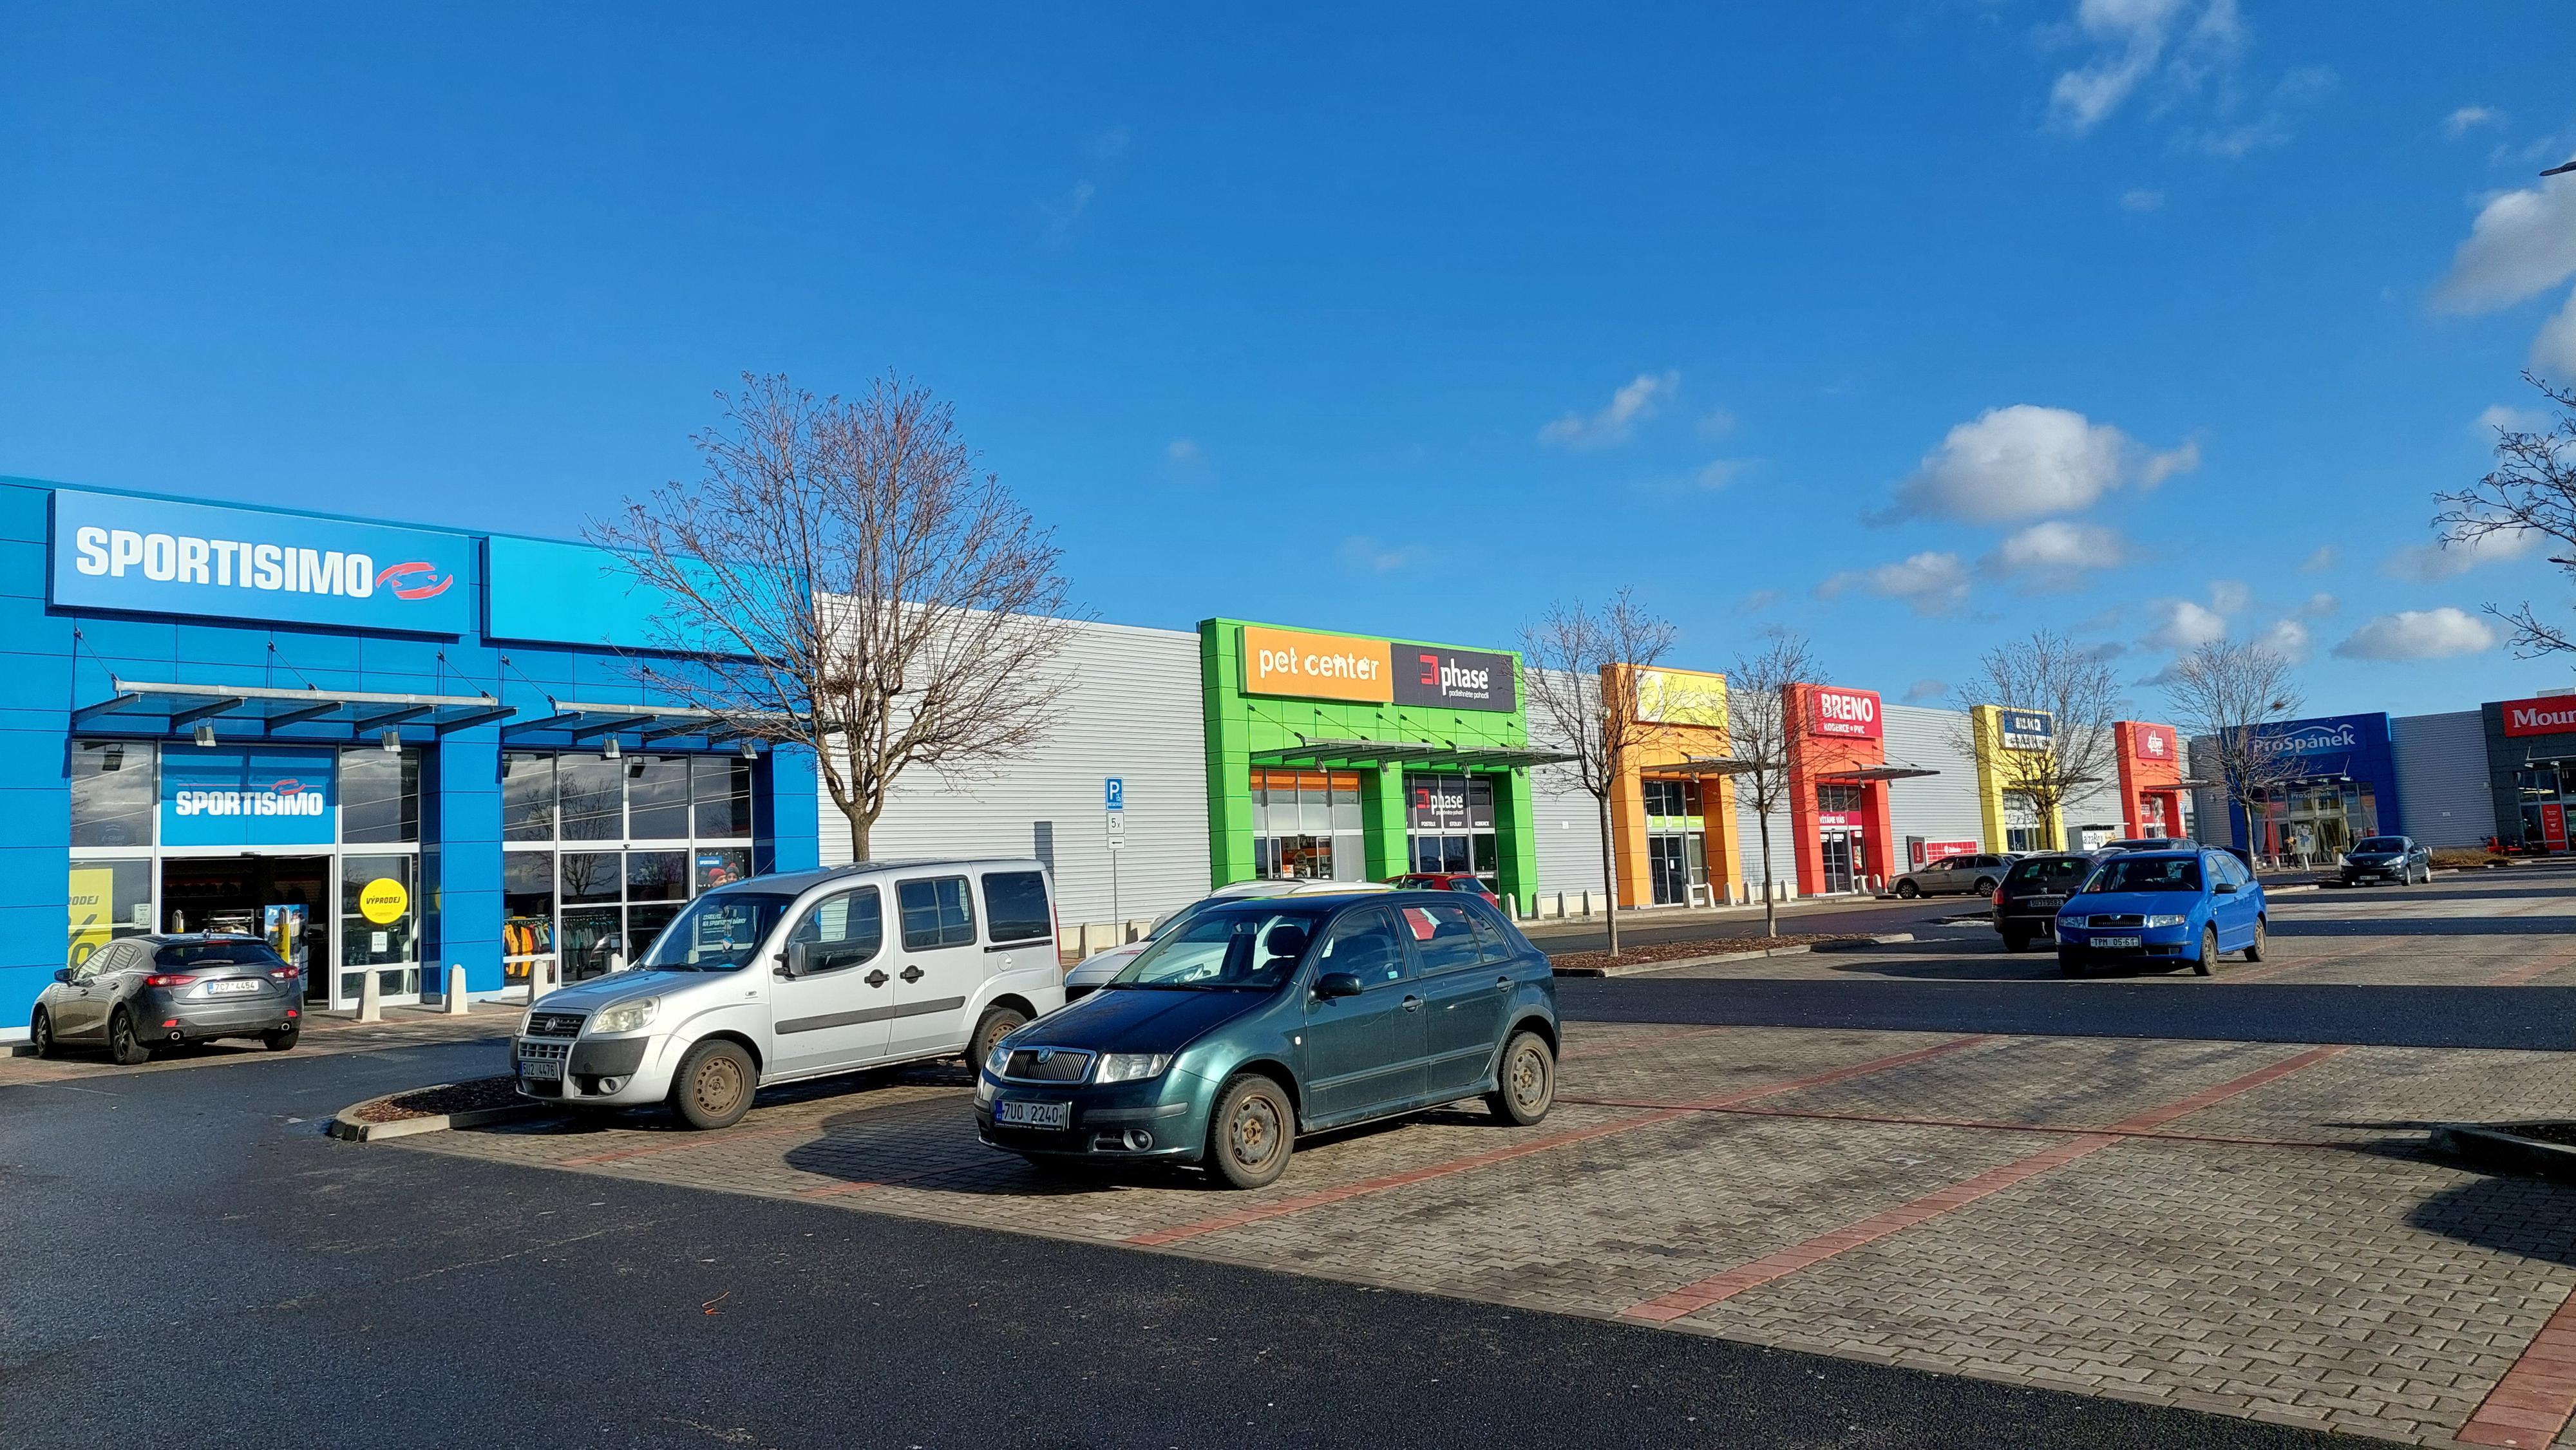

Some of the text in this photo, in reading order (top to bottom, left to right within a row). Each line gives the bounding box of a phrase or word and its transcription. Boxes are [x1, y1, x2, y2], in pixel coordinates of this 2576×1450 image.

[76, 526, 374, 599] SPORTISIMO
[1259, 646, 1381, 681] pet center
[1441, 658, 1488, 695] phase
[1821, 693, 1873, 722] BRENO
[1824, 722, 1865, 733] KOBERCE PVC
[2255, 730, 2356, 754] ProSpánek
[1110, 781, 1120, 800] P
[176, 791, 323, 816] SPORTISIMO
[366, 896, 401, 904] VÝPRODEJ
[215, 983, 229, 991] 7C7
[523, 1063, 555, 1077] 5U2 4476
[1004, 1103, 1059, 1123] 7U0 2240
